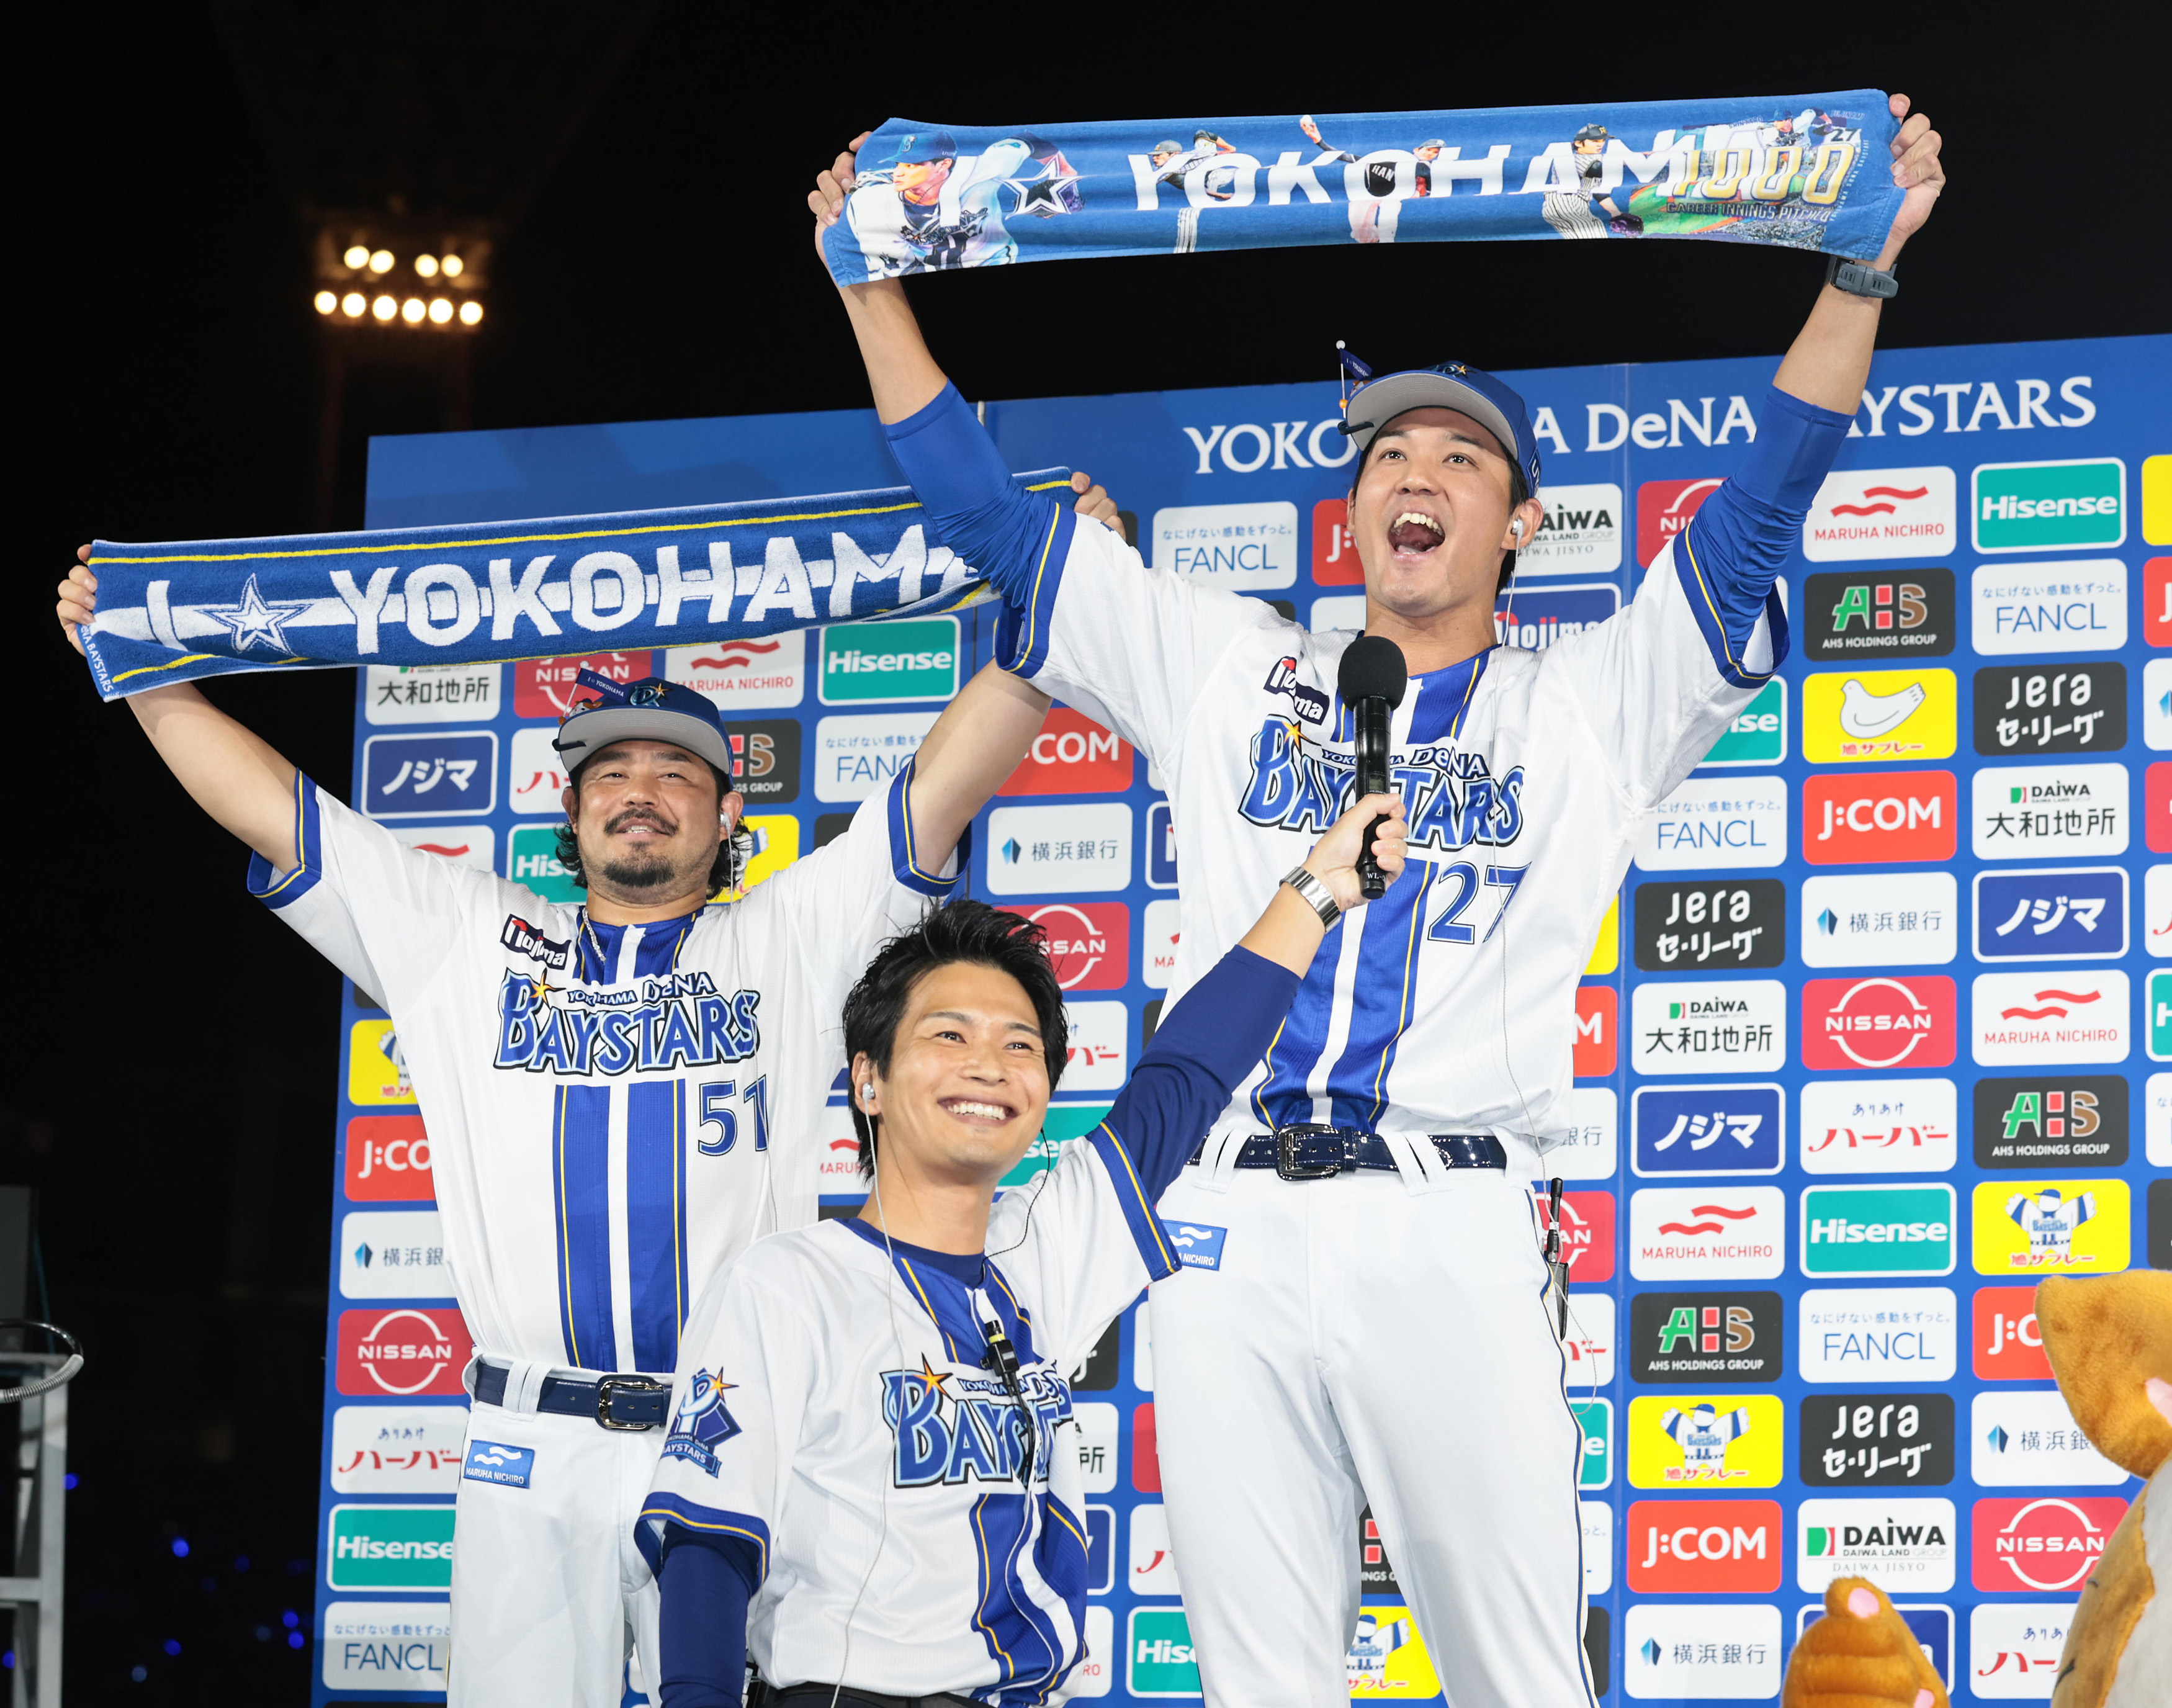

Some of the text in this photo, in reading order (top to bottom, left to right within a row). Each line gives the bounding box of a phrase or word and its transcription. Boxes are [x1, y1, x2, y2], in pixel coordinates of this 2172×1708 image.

[1831, 128, 1861, 142] 27
[1672, 142, 1856, 206] 1000
[1666, 202, 1718, 214] CAREER
[1722, 203, 1776, 220] INNINGS
[1584, 393, 1757, 454] DeNA
[1844, 376, 2097, 438] YSTARS
[1981, 495, 2118, 521] Hisense
[1815, 523, 1945, 541] MARUHA NICHIRO
[1175, 542, 1281, 575] FANCL
[329, 524, 979, 655] YOKOHAM
[1983, 583, 2120, 599] なにげない感動をずっと。
[1996, 603, 2107, 634] FANCL
[1822, 634, 1937, 649] AHS HOLDINGS GROUP
[86, 643, 114, 692] BAYSTARS
[827, 652, 953, 673] Hisense
[377, 676, 490, 706] 大和地所
[595, 679, 625, 698] YOKOHAMA
[738, 675, 794, 690] NICHIRO
[1024, 730, 1120, 765] COM
[1409, 746, 1490, 779] DeNA
[382, 758, 478, 795] ノジマ
[749, 781, 783, 793] GROUP
[1237, 713, 1525, 852] BAYTARS
[1656, 799, 1781, 814] にげない感動をずっと。
[1817, 796, 1941, 841] J:COM
[1658, 819, 1767, 850] FANCL
[1986, 807, 2116, 839] 大和地所
[1031, 840, 1118, 861] 横浜銀行
[1427, 860, 1533, 945] 27
[1849, 910, 1942, 933] 横浜銀行
[1995, 896, 2106, 937] ノジマ
[504, 916, 567, 968] nojima
[642, 971, 719, 1004] DeNA
[493, 966, 761, 1076] BAYSTARS
[1825, 1013, 1932, 1032] NISSAN
[1646, 1024, 1773, 1054] 大和地所
[1985, 1028, 2118, 1044] MARUHA NICHIRO
[698, 1073, 770, 1156] 51
[1852, 1102, 1905, 1117] ありあけ
[1654, 1112, 1762, 1152] ノジマ
[1808, 1125, 1949, 1153] ハーバー
[357, 1139, 432, 1179] J:CO
[1991, 1143, 2111, 1157] AHS HOLDINGS GROUP
[1810, 1218, 1948, 1244] Hisense
[382, 1246, 444, 1268] 横浜銀
[1183, 1254, 1215, 1267] NICHIRO
[1642, 1244, 1773, 1259] MARUHA NICHIRO
[1811, 1311, 1949, 1324] なにげない感動をずっと。
[357, 1344, 452, 1360] NISSAN
[1824, 1332, 1936, 1361] FANCL
[1648, 1359, 1764, 1371] AHS HOLDINGS GROUP
[378, 1427, 425, 1441] ありあけ
[2020, 1430, 2093, 1451] 横浜銀
[338, 1449, 462, 1473] ハーバー
[493, 1470, 525, 1485] NICHIRO
[336, 1535, 453, 1560] Hisense
[1641, 1526, 1767, 1568] J:COM
[1843, 1547, 1949, 1557] DAIWA LAND GROUP
[1995, 1535, 2105, 1553] NISSAN
[1833, 1562, 1925, 1573] DAIWA JISYO
[333, 1623, 451, 1637] なにげない感動をずっと
[344, 1643, 443, 1671] FANCL
[1673, 1643, 1766, 1665] 横浜銀行
